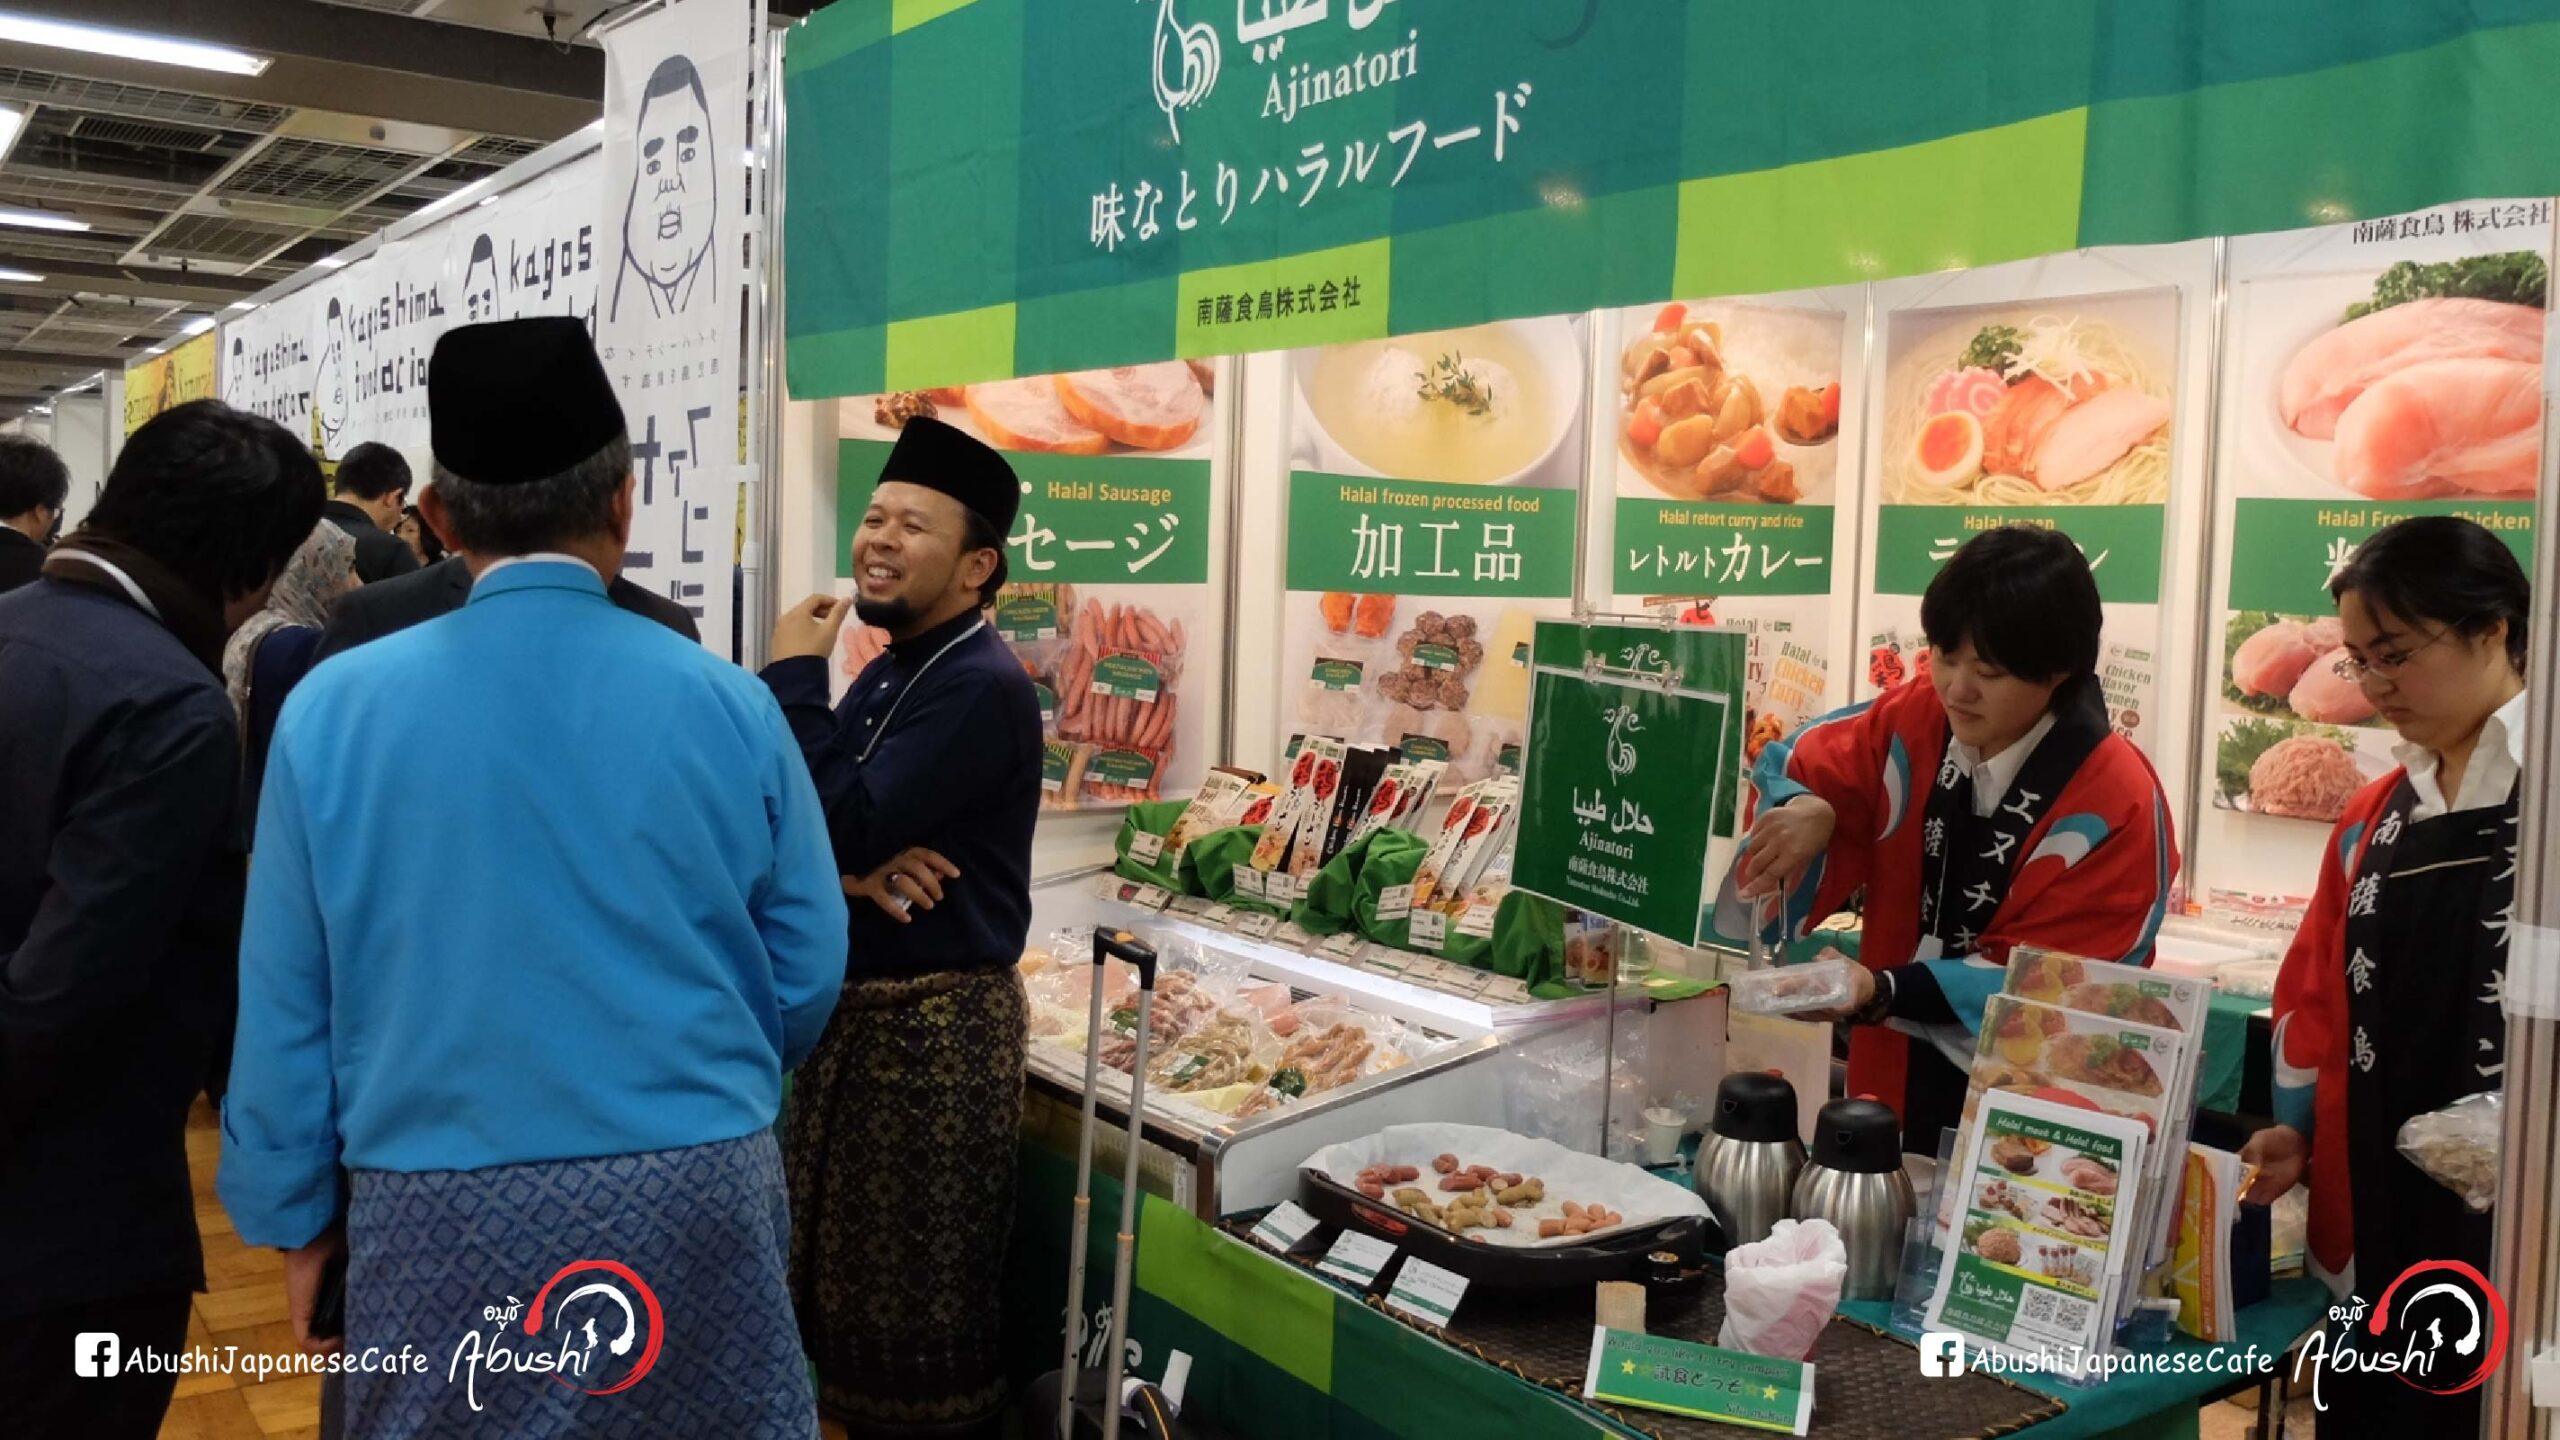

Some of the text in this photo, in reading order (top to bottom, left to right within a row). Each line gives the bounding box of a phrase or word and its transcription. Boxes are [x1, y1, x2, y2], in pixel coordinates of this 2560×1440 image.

[1261, 29, 1418, 124] Ajinatori
[1090, 82, 1532, 253] 味なとりハラルフード
[2352, 201, 2552, 245] 南薩食鳥 株式会社
[509, 224, 592, 301] kagos
[1197, 276, 1361, 327] 南薩食鳥株式会社
[1048, 481, 1172, 506] Halal Sausage
[1340, 485, 1540, 513] Halal frozen processed food
[1659, 509, 1804, 530] Halal retort curry and rice
[1963, 514, 2002, 530] Halal
[2318, 510, 2365, 527] Halal
[1350, 514, 1522, 582] 加工品
[1629, 532, 1823, 584] レトルトカレー
[1572, 786, 1656, 835] حلال طيبا
[1579, 830, 1634, 860] Ajinatori
[2346, 810, 2402, 1074] 南薩食鳥
[2052, 1129, 2061, 1141] &
